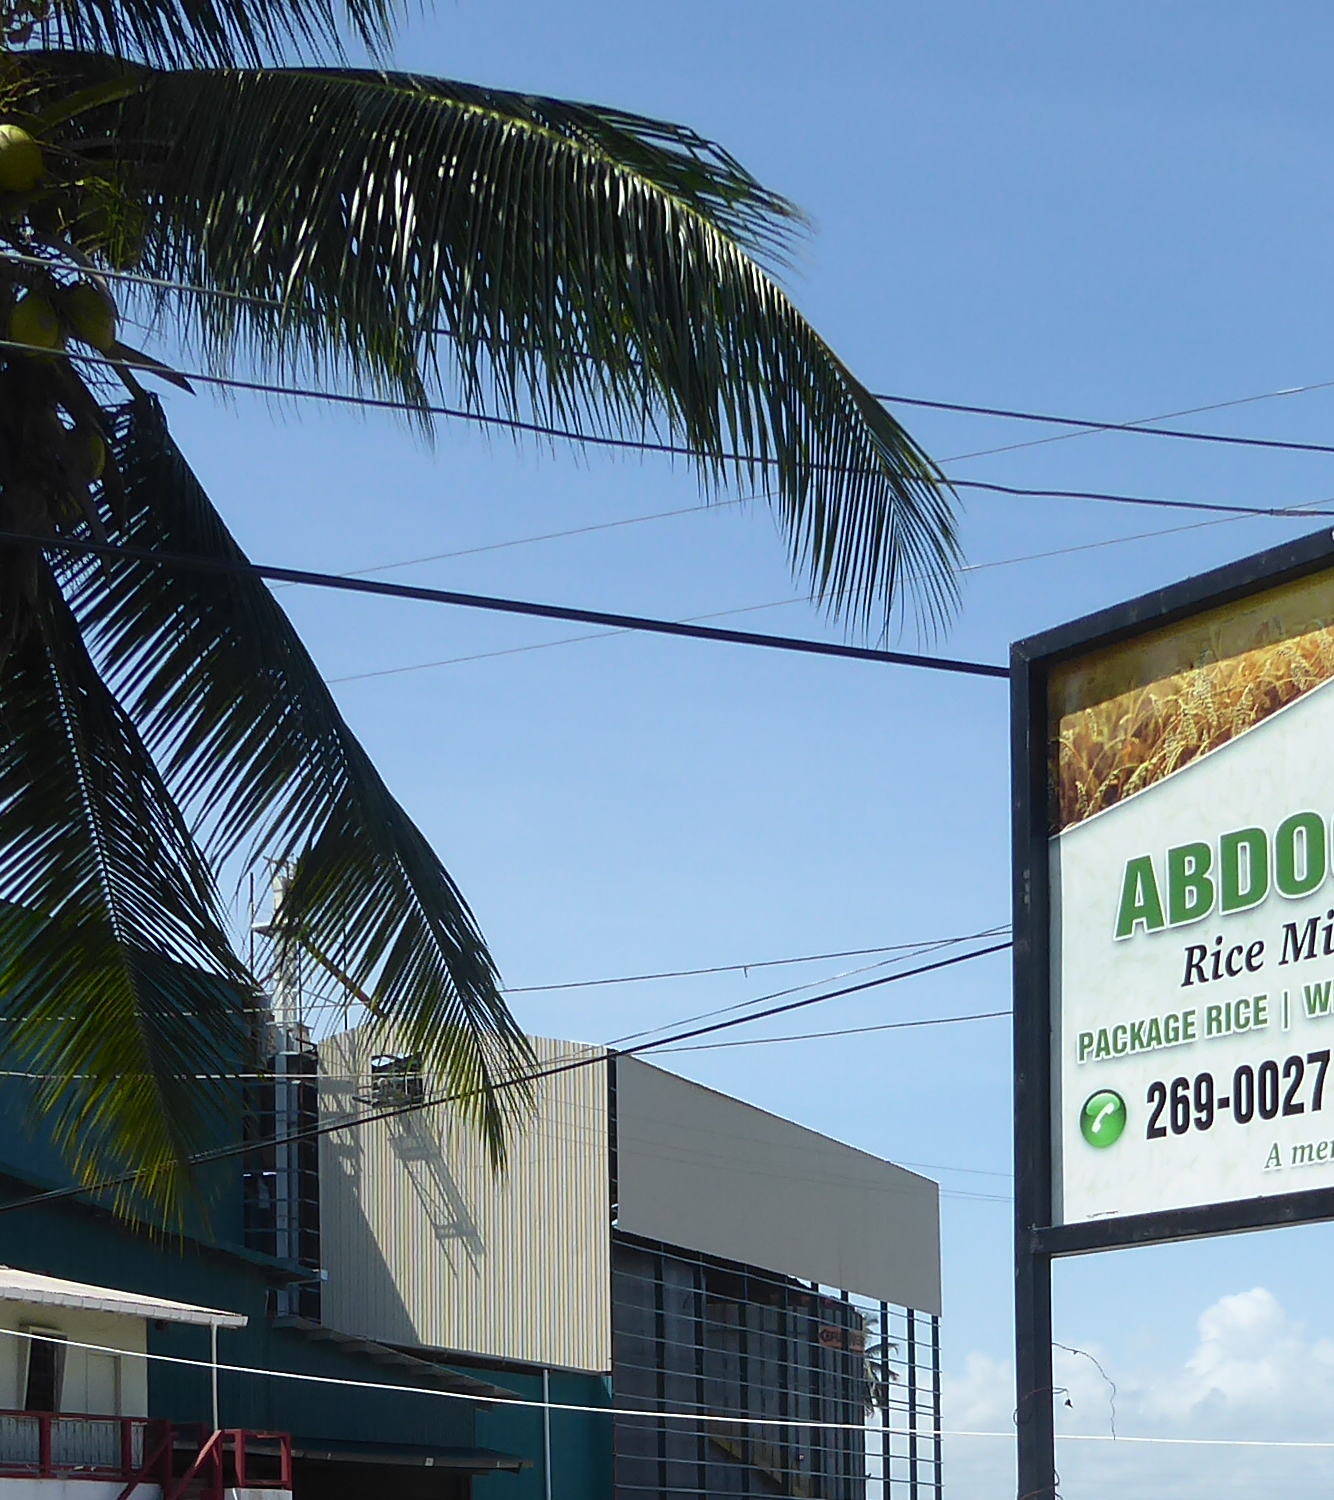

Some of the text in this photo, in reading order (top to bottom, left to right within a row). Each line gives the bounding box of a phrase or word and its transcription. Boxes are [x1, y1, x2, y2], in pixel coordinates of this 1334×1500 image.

[1180, 935, 1265, 988] Rice
[1078, 1009, 1196, 1062] PACKAGE
[1206, 994, 1268, 1036] RICE
[1146, 1048, 1331, 1140] 269-0027
[1264, 1142, 1282, 1169] A
